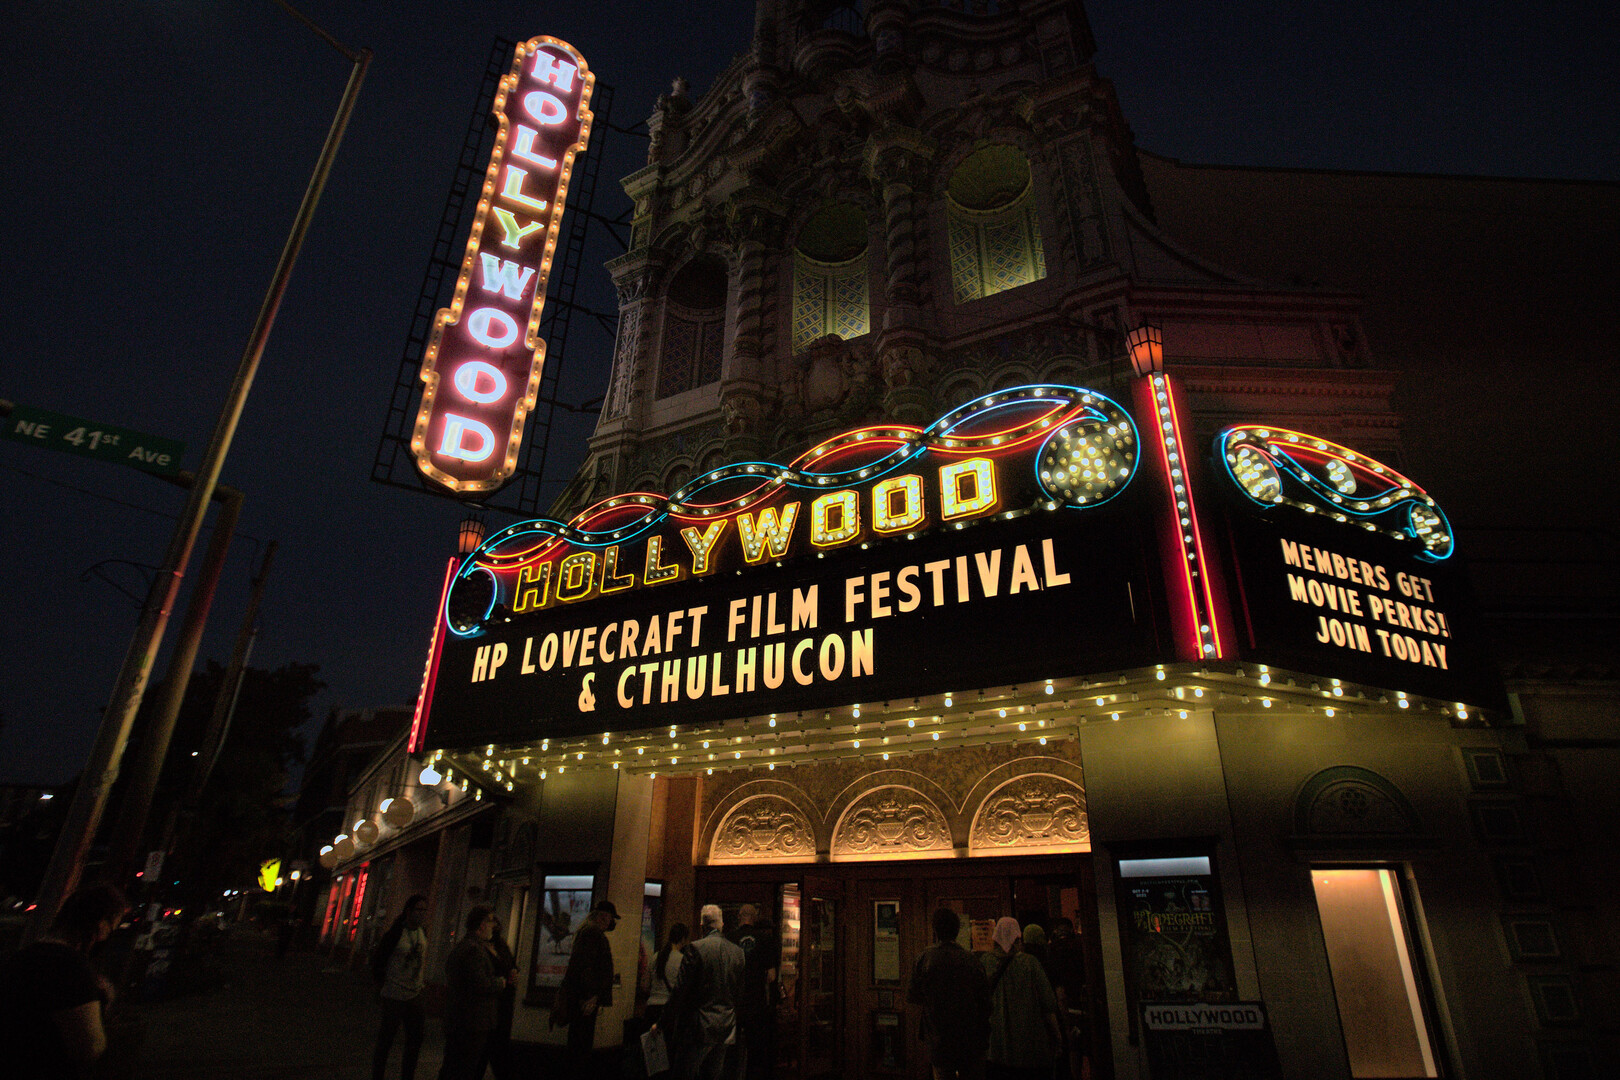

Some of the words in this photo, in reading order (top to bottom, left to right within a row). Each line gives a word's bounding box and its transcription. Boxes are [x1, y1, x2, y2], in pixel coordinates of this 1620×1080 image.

[437, 50, 577, 463] HOLLYWOOD
[14, 420, 51, 439] NE
[63, 427, 121, 450] 41st
[128, 446, 171, 466] Ave
[513, 457, 997, 612] HOLLYWOOD
[1281, 538, 1390, 591] MEMBERS
[1396, 571, 1434, 603] GET
[471, 642, 508, 683] HP
[520, 605, 708, 675] LOVECRAFT
[727, 584, 818, 642] FILM
[845, 538, 1071, 623] FESTIVAL
[1287, 573, 1364, 617] MOVIE
[1368, 594, 1449, 638] PERKS!
[578, 672, 596, 712] &
[616, 628, 874, 709] CTHULHUCON
[1316, 615, 1372, 653] JOIN
[1375, 628, 1448, 670] TODAY
[1151, 1009, 1258, 1024] HOLLYWOOD
